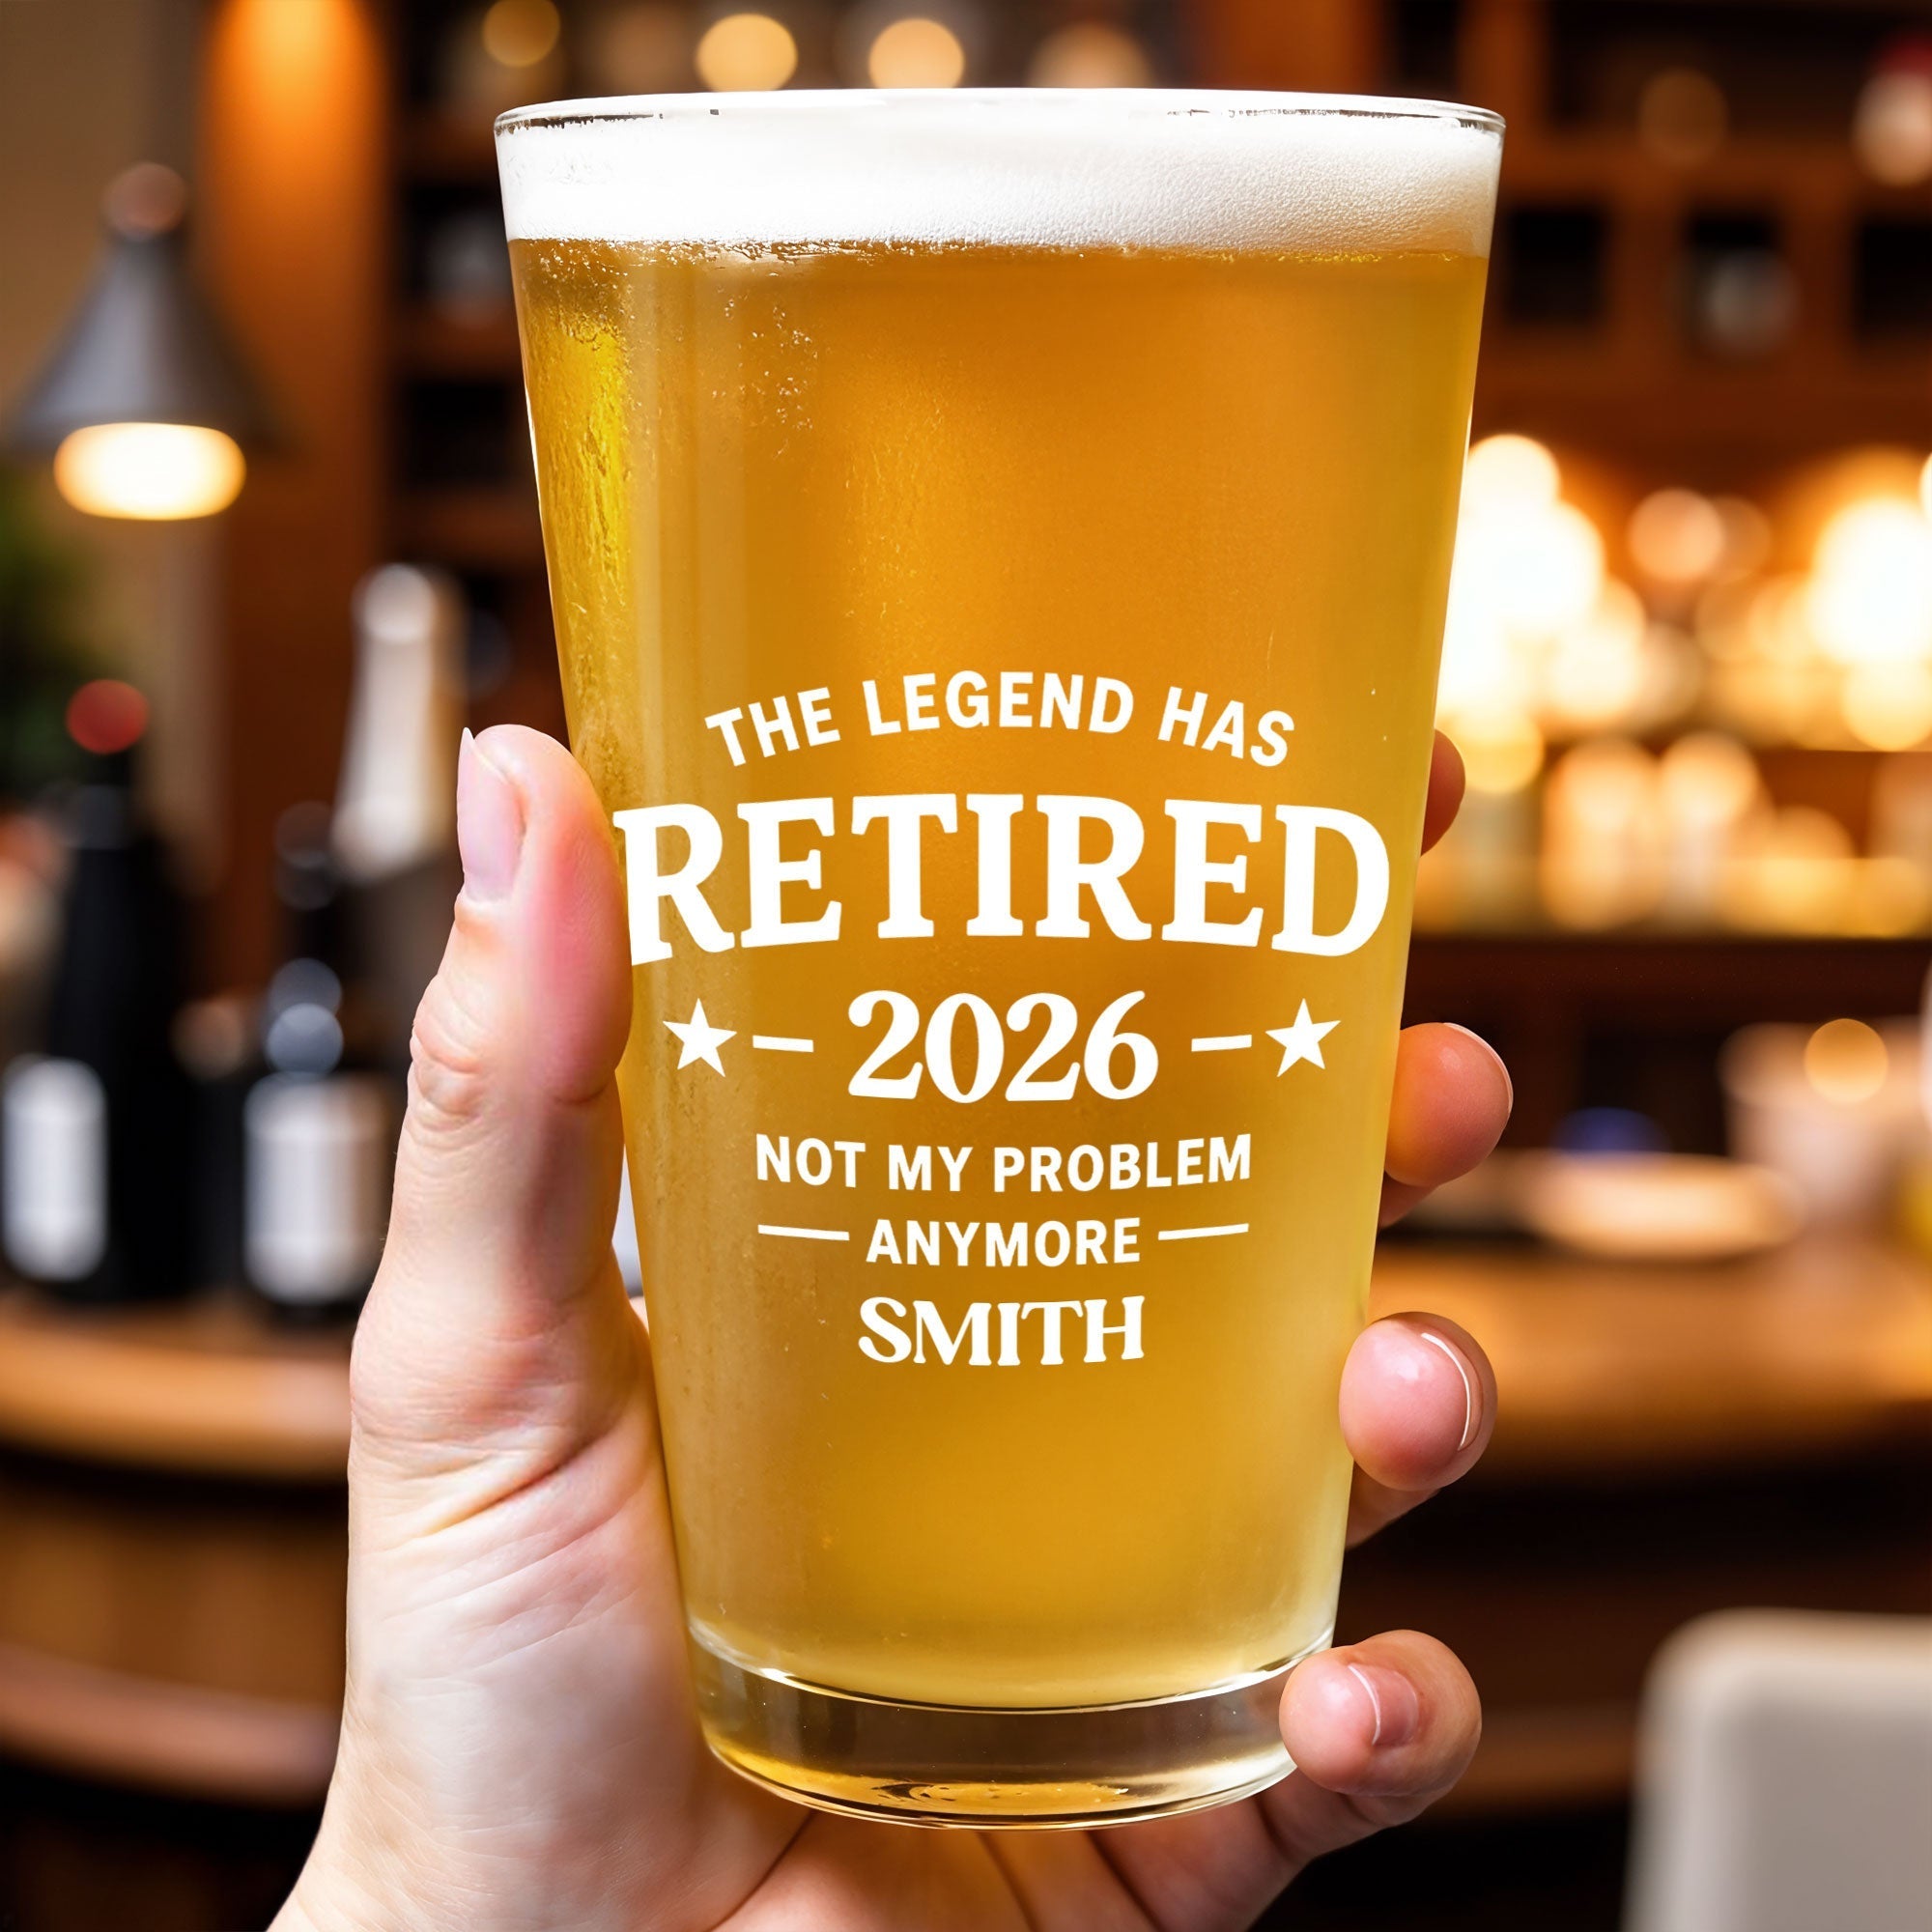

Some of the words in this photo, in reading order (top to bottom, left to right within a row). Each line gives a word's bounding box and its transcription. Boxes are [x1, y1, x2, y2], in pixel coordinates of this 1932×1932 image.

[705, 688, 840, 766] THE
[862, 670, 1134, 736] LEGEND
[1158, 686, 1295, 767] HAS
[612, 793, 1391, 966] RETIRED
[847, 990, 1159, 1103] 2026
[755, 1133, 866, 1187] NOT
[888, 1145, 973, 1192] MY
[994, 1133, 1252, 1192] PROBLEM
[866, 1217, 1141, 1267] ANYMORE
[858, 1295, 1145, 1366] SMITH
